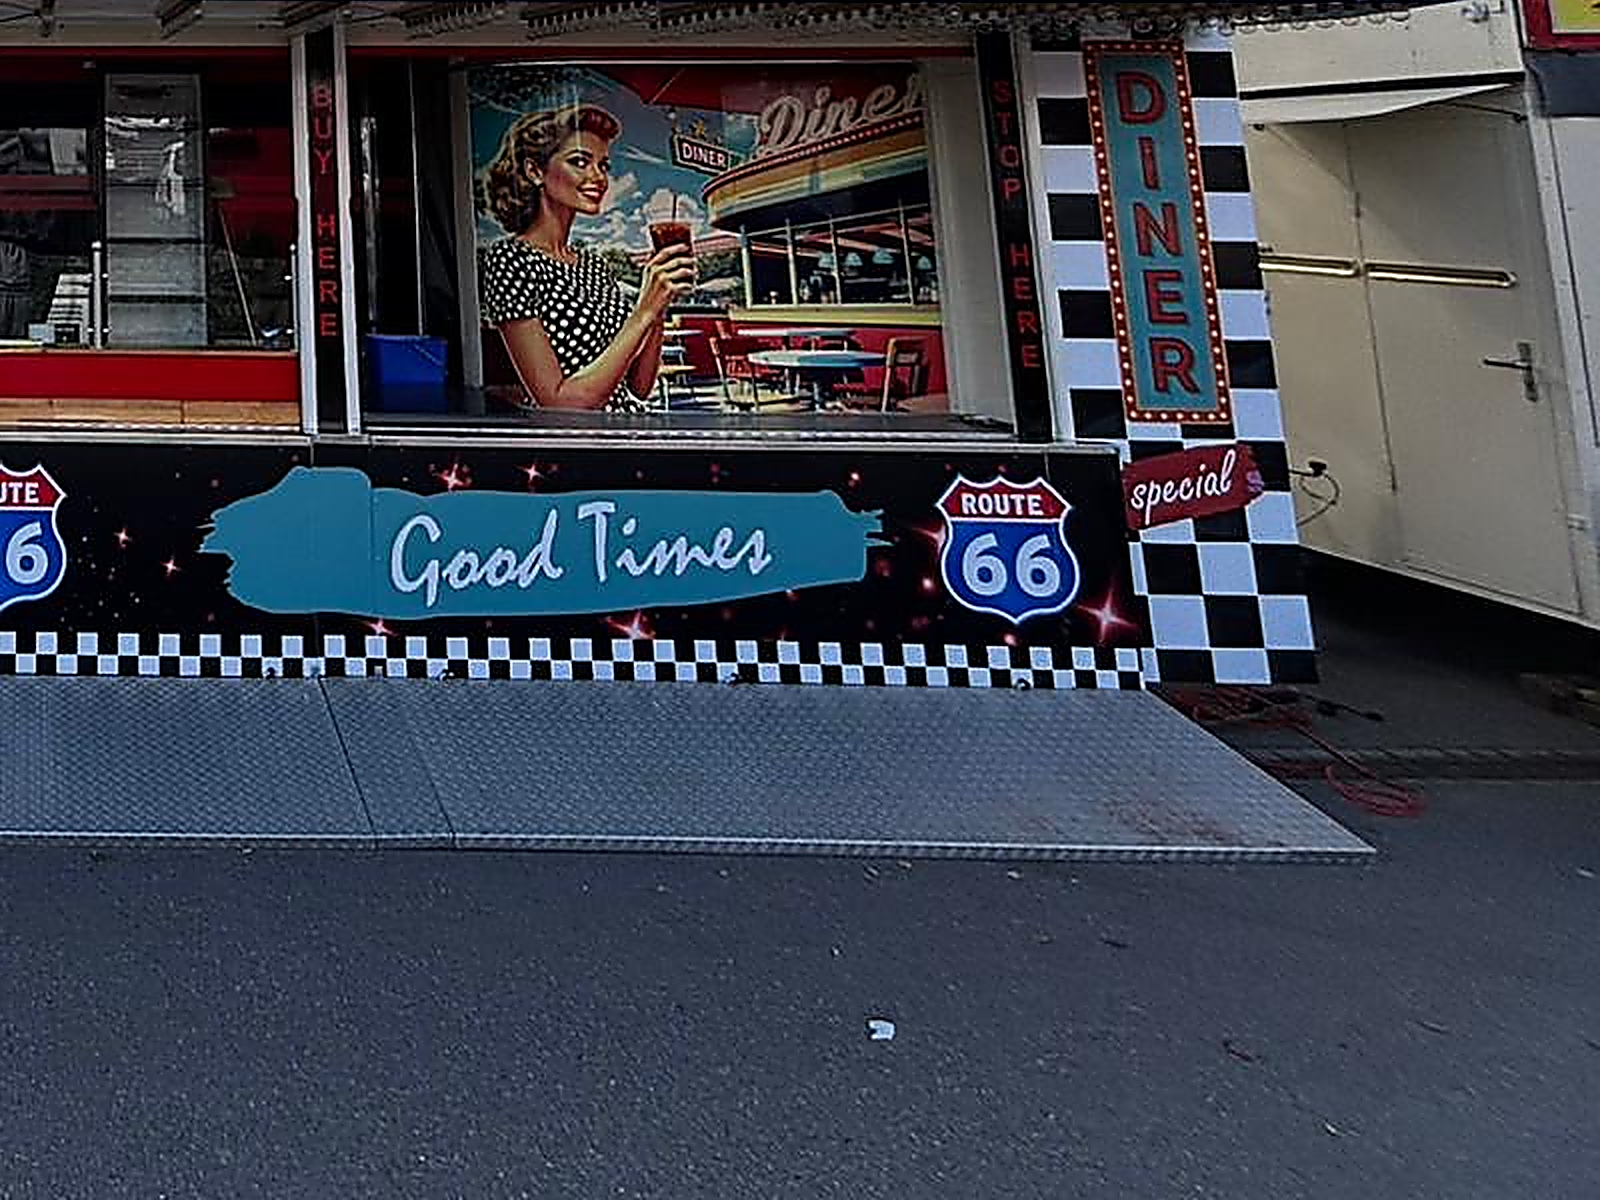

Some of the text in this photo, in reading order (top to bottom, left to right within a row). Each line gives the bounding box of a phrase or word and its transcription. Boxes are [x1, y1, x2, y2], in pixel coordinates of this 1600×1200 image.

[680, 141, 728, 170] DINER
[311, 84, 338, 337] BUY HERE
[990, 80, 1042, 369] STOP HERE
[1114, 69, 1201, 396] DINER
[960, 492, 1045, 516] ROUTE
[1130, 448, 1236, 526] special
[390, 500, 773, 608] Good Times
[962, 532, 1060, 598] 66
